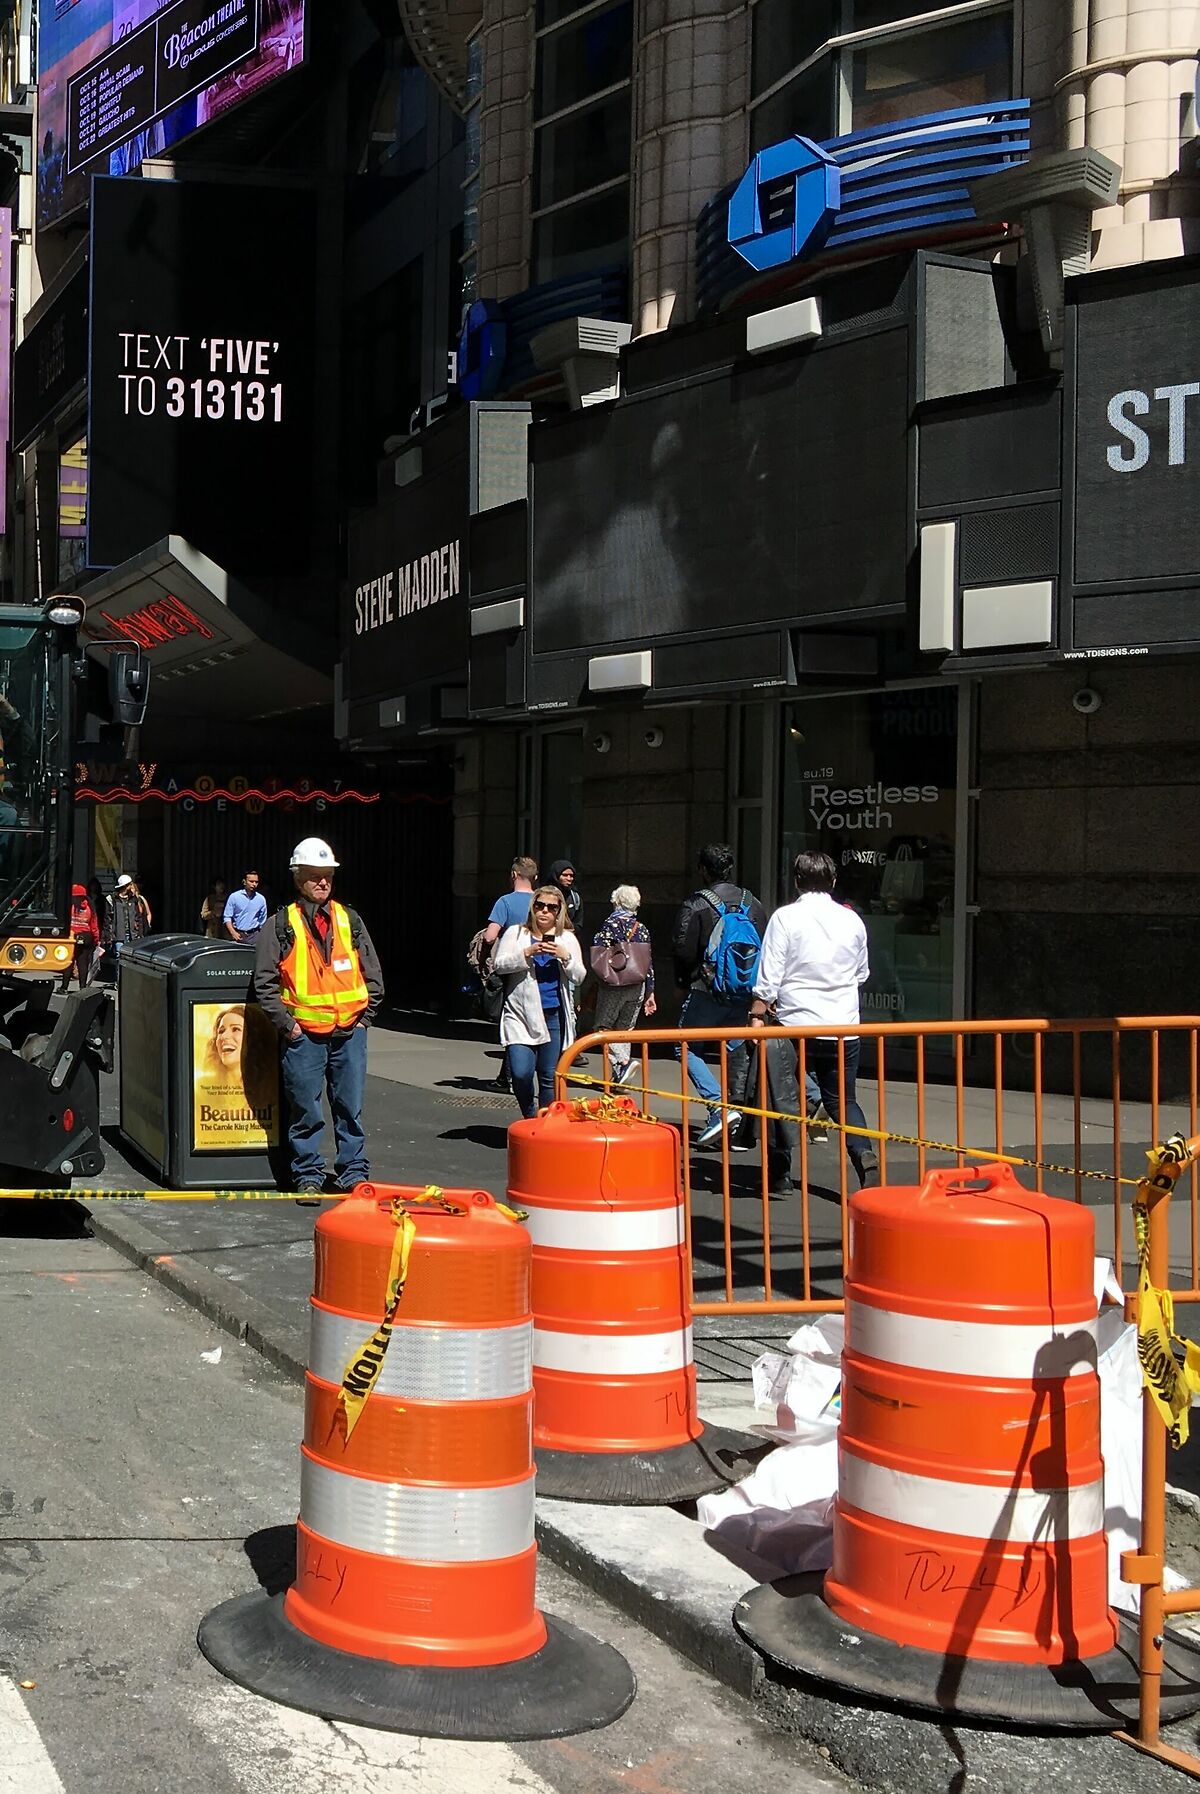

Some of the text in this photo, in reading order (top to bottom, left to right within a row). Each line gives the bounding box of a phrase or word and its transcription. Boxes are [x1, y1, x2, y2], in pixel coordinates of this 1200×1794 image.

[189, 37, 216, 62] LEXUS
[99, 81, 122, 103] POPULAR
[122, 65, 145, 87] DEMAND
[97, 113, 124, 138] GREATEST
[98, 105, 120, 126] GAUCHO
[118, 333, 190, 371] TEXT
[118, 375, 283, 422] TO 313131
[355, 539, 460, 636] STEVE MADDEN
[1063, 646, 1149, 661] www.TDISIGNS.com
[803, 766, 834, 780] su.19
[167, 779, 178, 792] A
[199, 779, 212, 792] Q
[234, 779, 245, 792] R
[299, 779, 310, 792] 3
[333, 779, 343, 792] 7
[809, 781, 940, 807] Restless
[183, 798, 194, 812] C
[217, 798, 227, 812] E
[315, 798, 326, 812] S
[808, 807, 894, 831] Youth
[206, 968, 253, 977] SOLAR COMPAC
[200, 1104, 273, 1122] Beautiful
[234, 1124, 249, 1132] King
[905, 1550, 1041, 1623] TULLY
